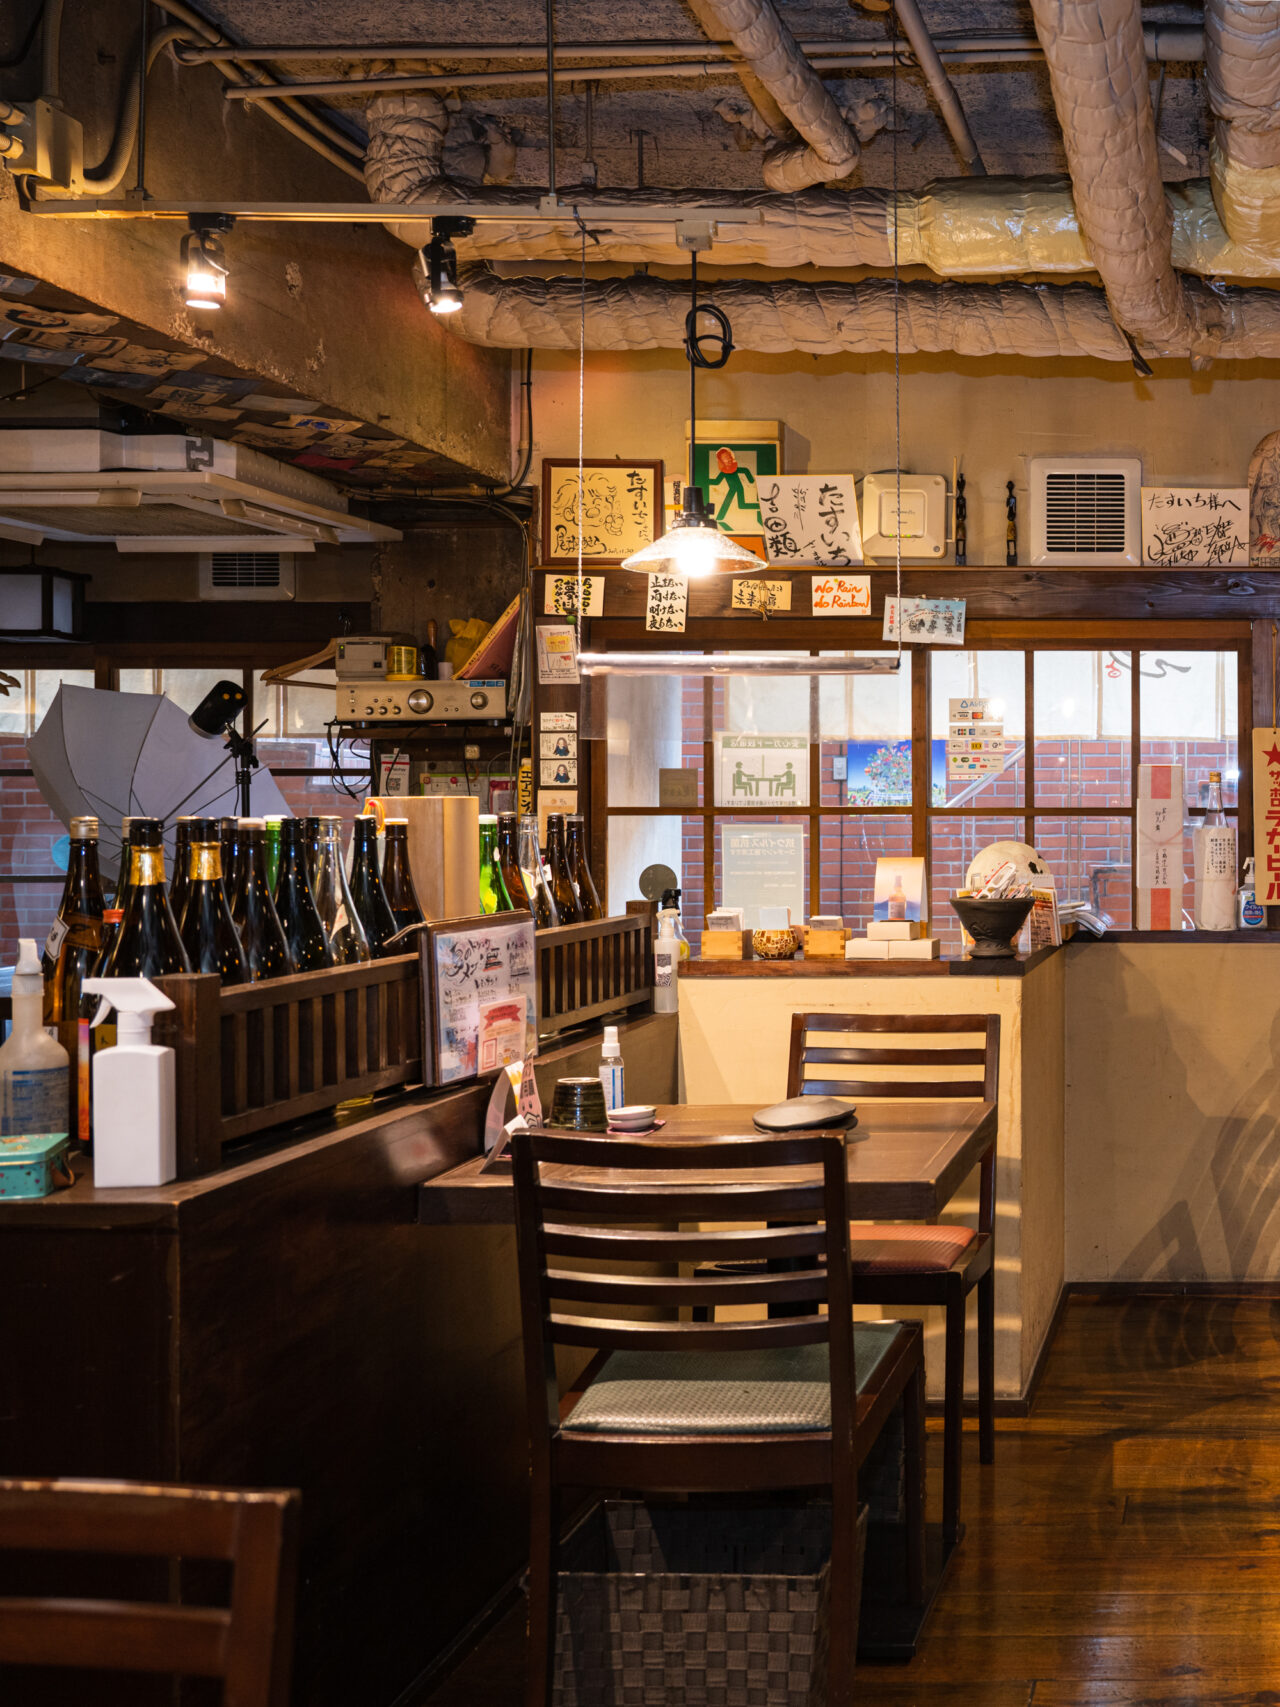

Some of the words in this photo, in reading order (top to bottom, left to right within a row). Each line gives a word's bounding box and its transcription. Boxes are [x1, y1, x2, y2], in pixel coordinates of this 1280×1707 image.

[1148, 492, 1242, 511] たすいち様へ
[814, 580, 833, 594] No
[836, 580, 863, 594] Rain
[814, 596, 830, 609] No
[832, 588, 870, 609] Rainbow
[649, 603, 684, 617] 明けない
